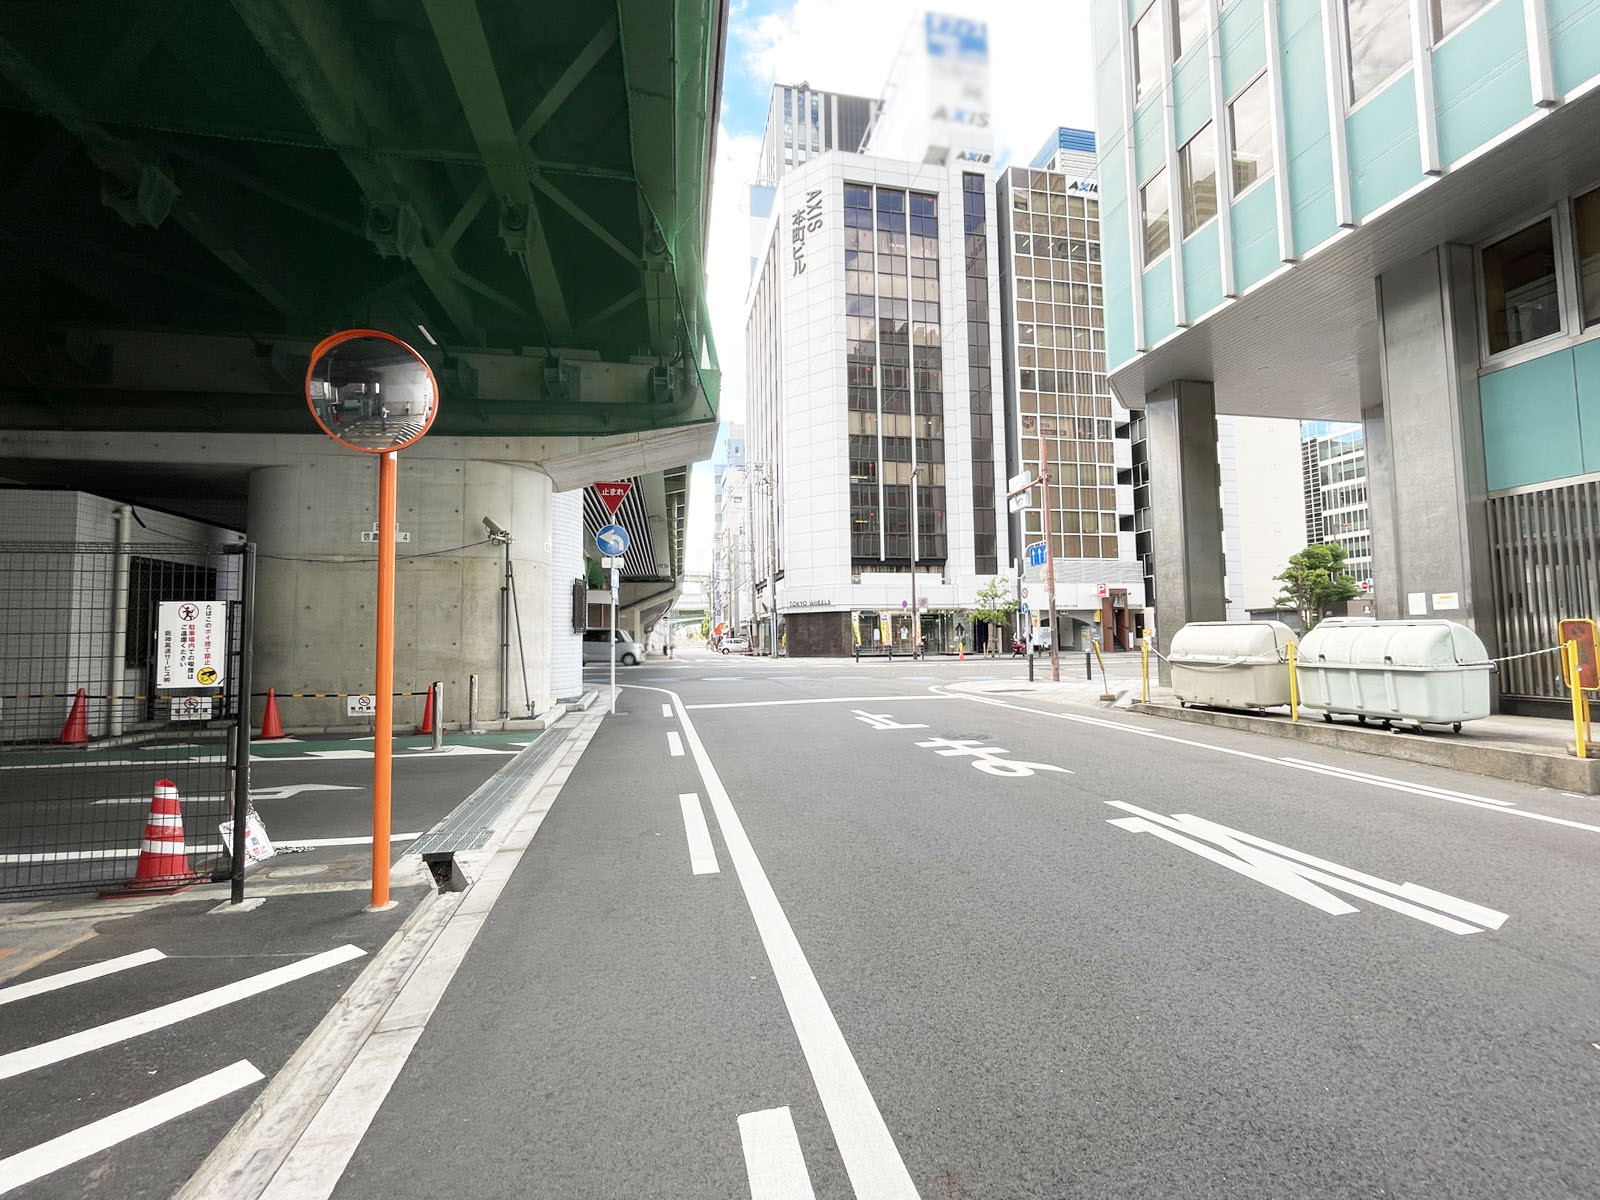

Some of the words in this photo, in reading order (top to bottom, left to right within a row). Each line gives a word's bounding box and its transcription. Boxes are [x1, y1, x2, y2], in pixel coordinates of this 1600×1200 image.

[956, 151, 991, 163] AXIS
[806, 189, 823, 233] AXIS
[792, 209, 806, 277] 本町ビル
[602, 487, 625, 496] 止まれ
